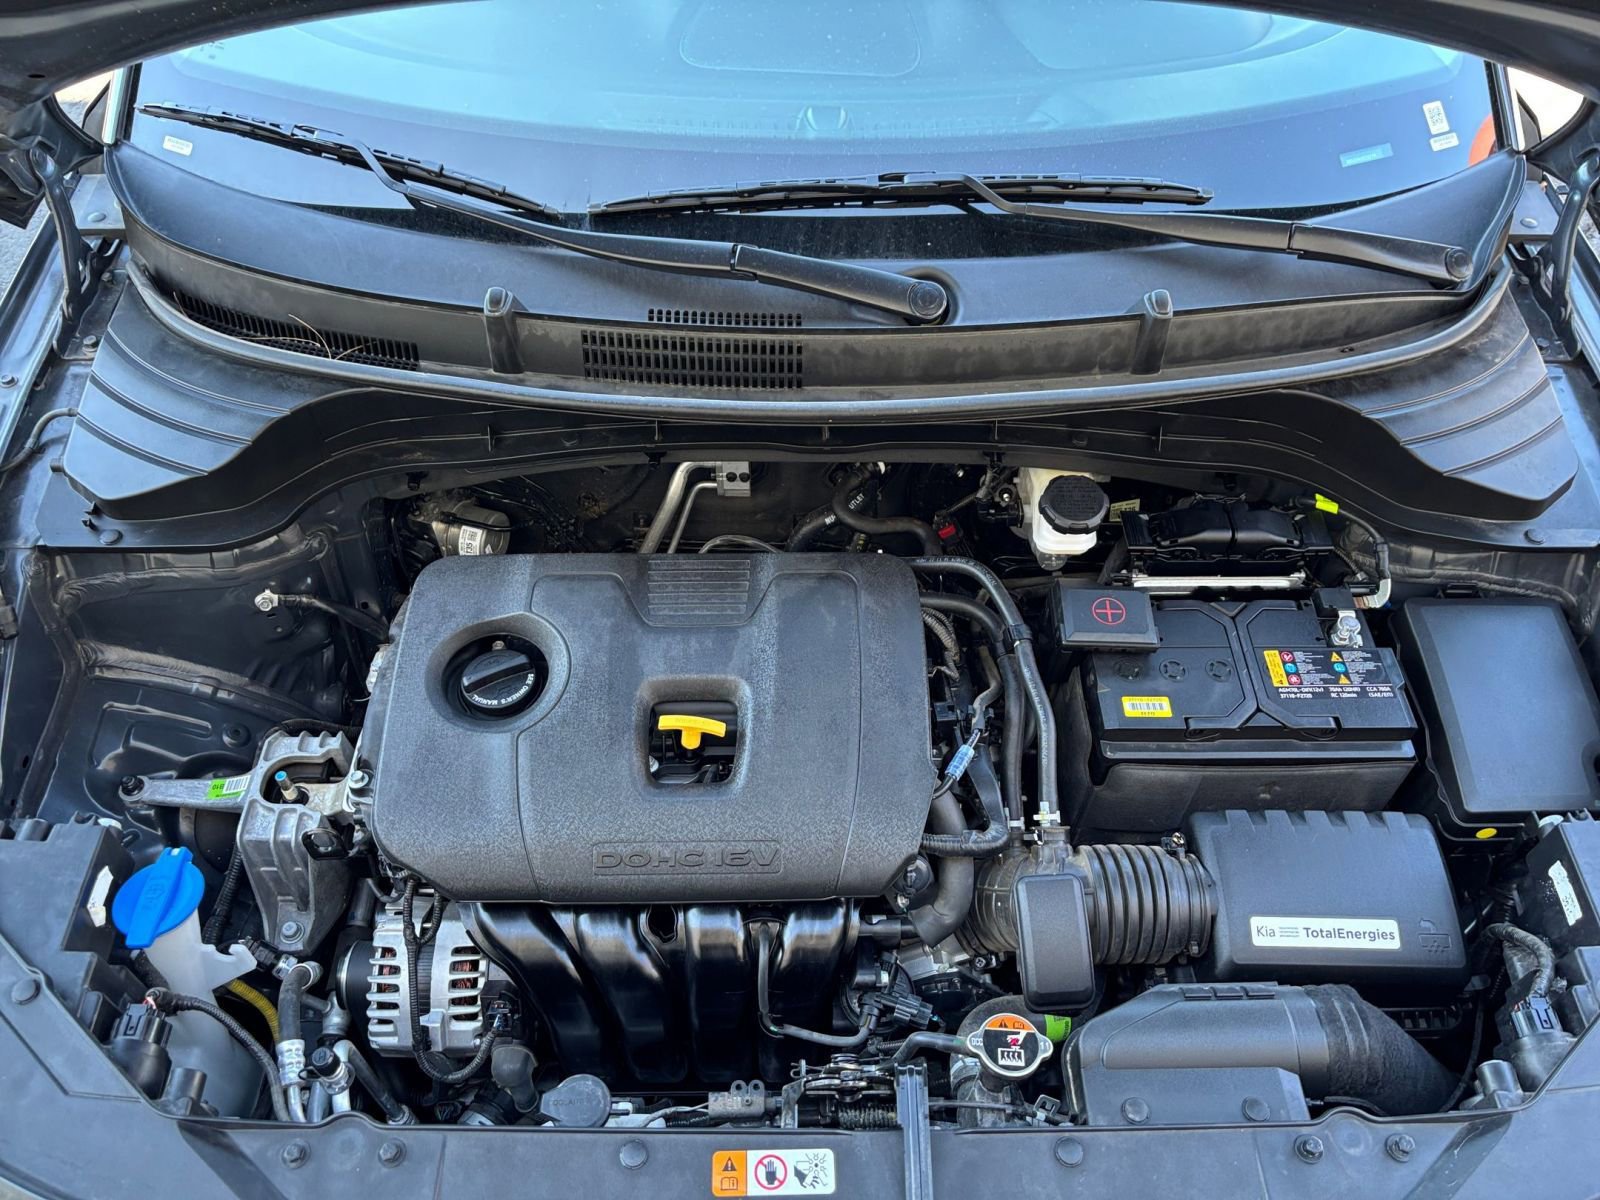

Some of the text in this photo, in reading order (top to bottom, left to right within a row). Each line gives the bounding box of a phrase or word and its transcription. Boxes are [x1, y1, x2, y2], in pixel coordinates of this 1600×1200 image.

[472, 673, 535, 706] SEE OWNER'S MANUAL
[595, 848, 778, 869] DOHC 16V
[1256, 925, 1276, 938] Kia
[1303, 927, 1396, 942] TotalEnergies
